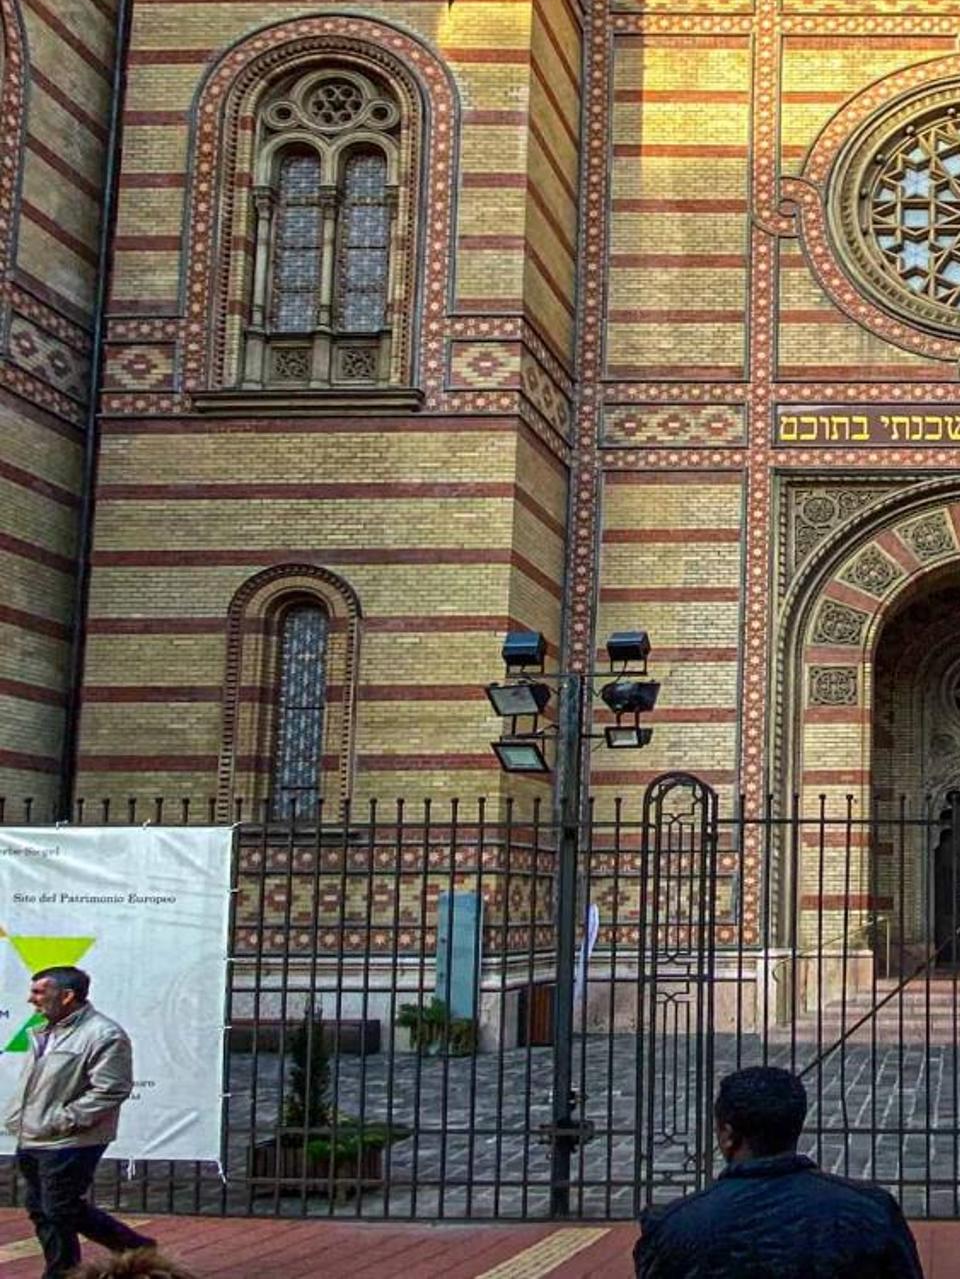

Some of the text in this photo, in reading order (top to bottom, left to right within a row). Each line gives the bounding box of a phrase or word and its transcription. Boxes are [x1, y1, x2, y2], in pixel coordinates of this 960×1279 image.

[779, 415, 871, 441] בתוכם
[60, 892, 125, 903] Patrimonio
[127, 892, 177, 905] Europeo
